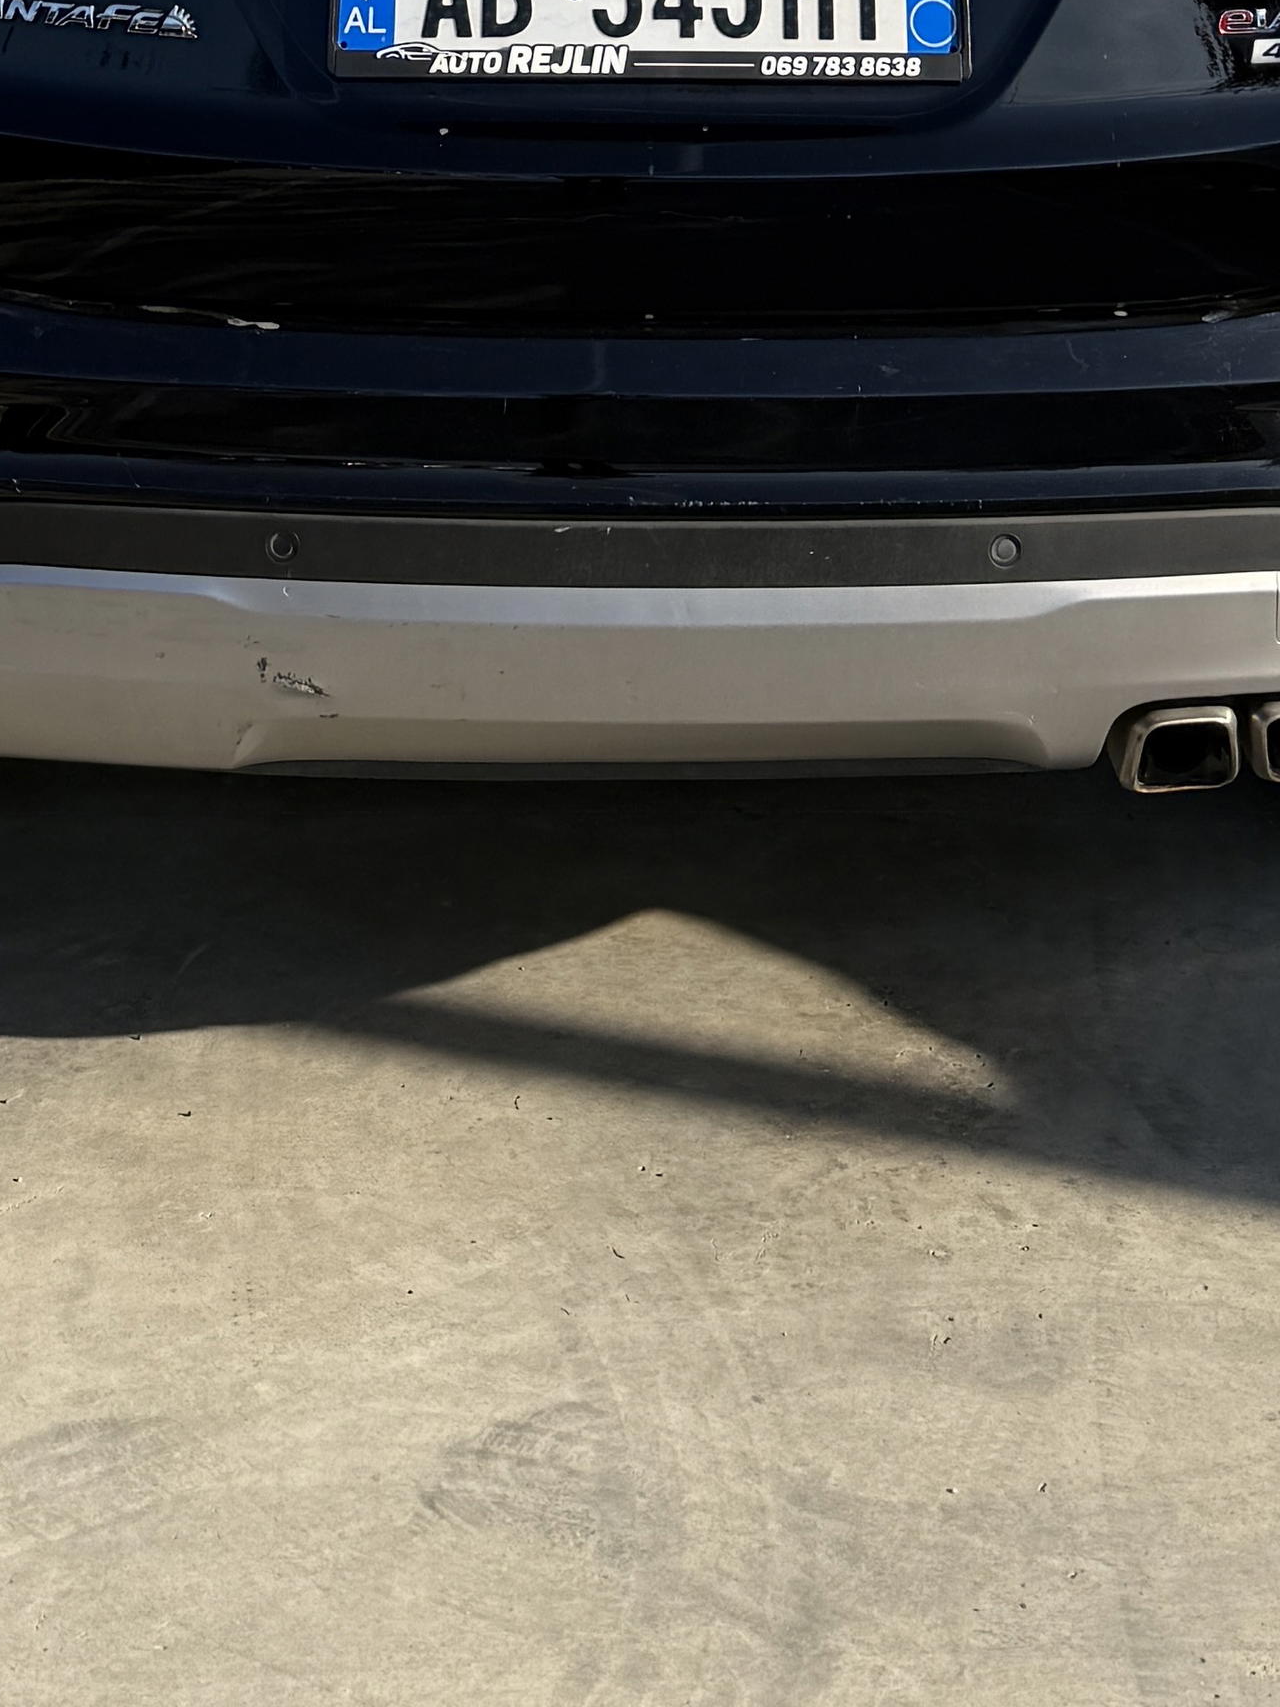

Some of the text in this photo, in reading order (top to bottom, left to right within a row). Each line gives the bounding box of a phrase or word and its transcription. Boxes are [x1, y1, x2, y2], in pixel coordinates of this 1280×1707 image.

[343, 6, 387, 34] AL
[428, 44, 630, 75] AUTO REJLIN
[761, 56, 921, 77] 069 783 8638
